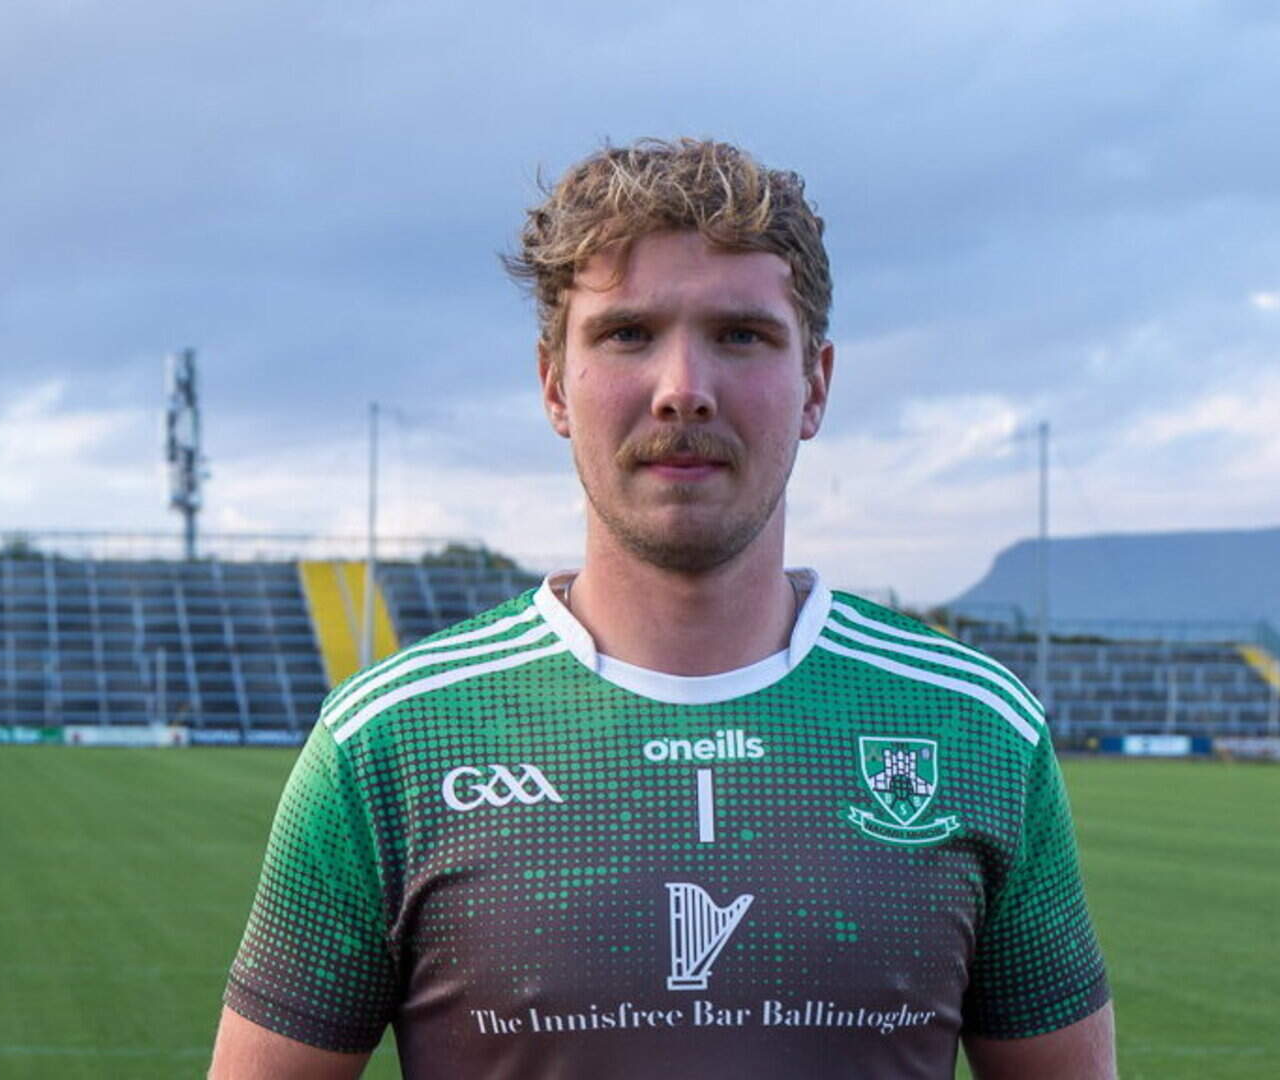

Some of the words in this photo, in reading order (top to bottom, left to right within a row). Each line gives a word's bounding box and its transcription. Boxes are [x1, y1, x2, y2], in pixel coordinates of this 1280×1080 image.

[442, 764, 564, 811] GAA
[470, 1009, 522, 1035] The
[530, 1002, 684, 1033] Innisfree
[692, 1001, 751, 1027] Bar
[762, 1001, 936, 1035] Ballintogher
